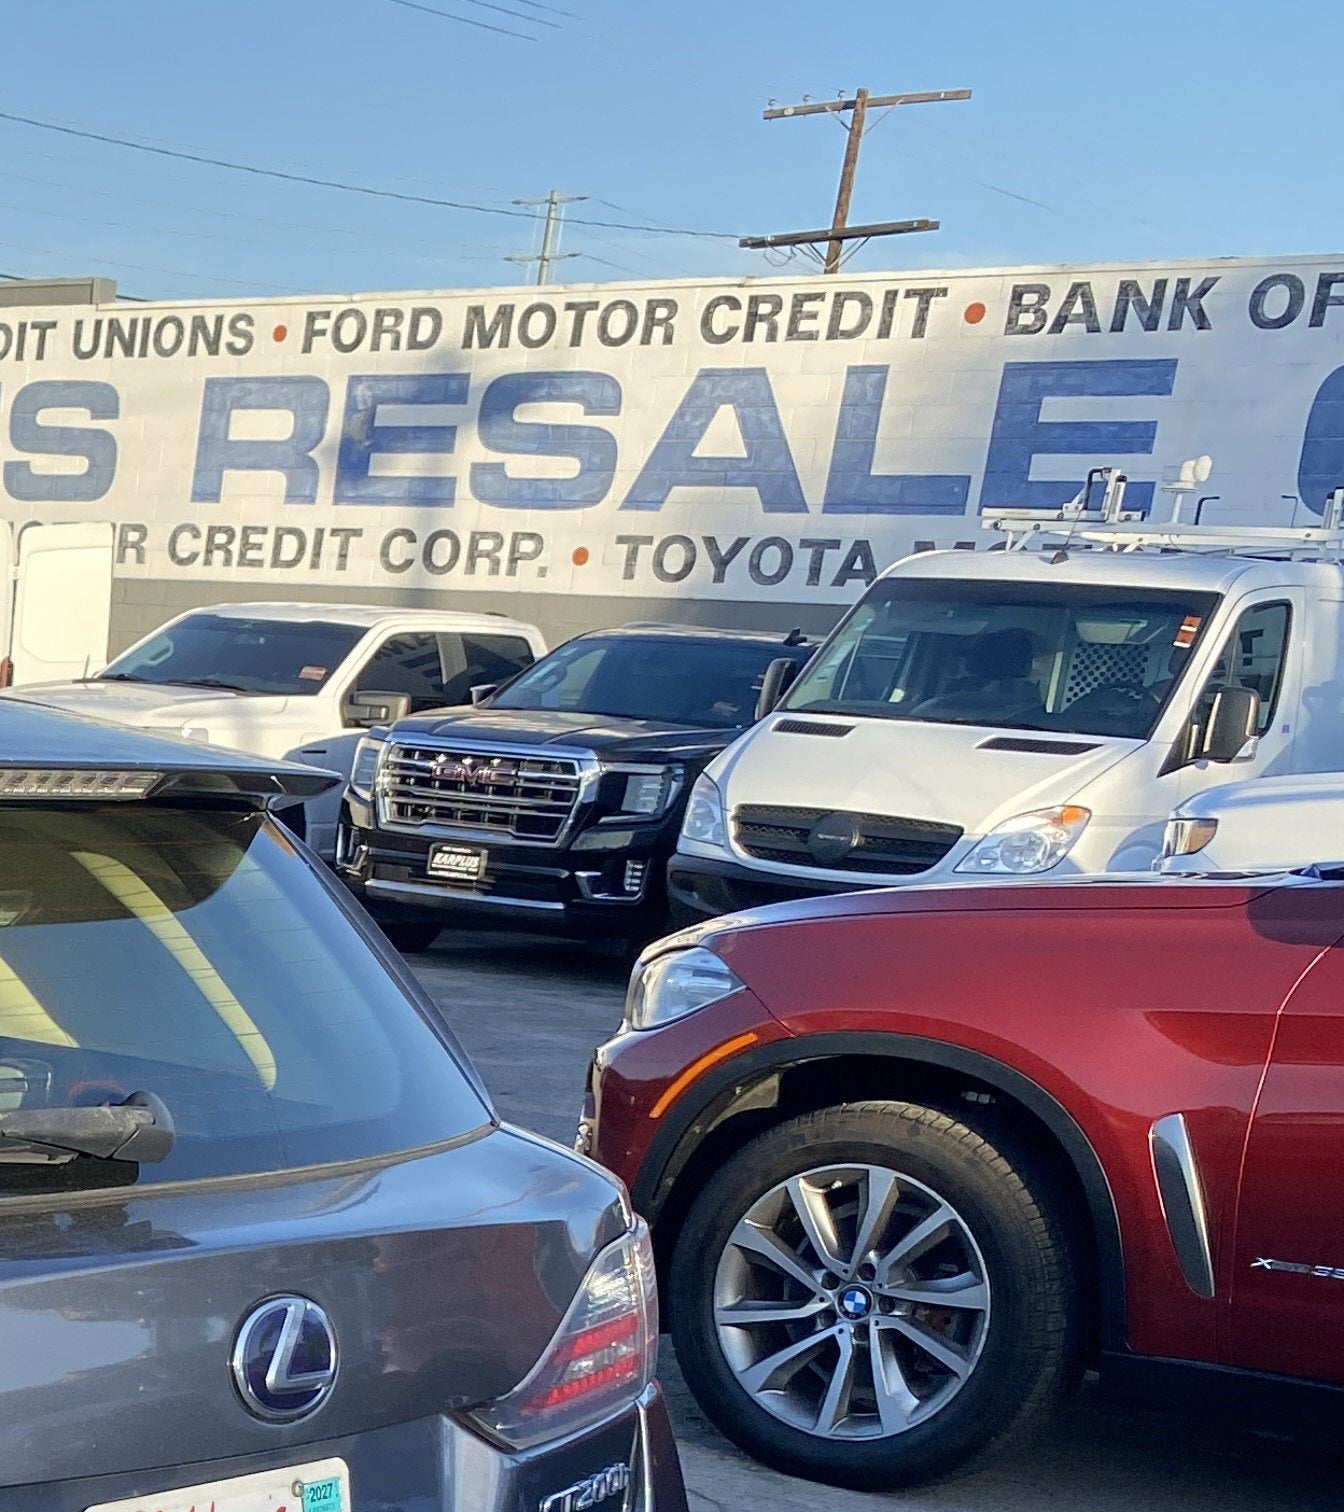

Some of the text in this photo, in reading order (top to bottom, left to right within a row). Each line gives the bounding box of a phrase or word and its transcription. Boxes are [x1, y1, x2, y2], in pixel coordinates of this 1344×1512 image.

[71, 313, 255, 361] UNIONS
[301, 307, 443, 354] FORD
[461, 298, 679, 350] MOTOR
[700, 286, 949, 344] CREDIT
[1003, 275, 1221, 336] BANK
[1248, 272, 1344, 330] OF
[190, 357, 1179, 518] RESALE
[167, 521, 363, 570] CREDIT
[379, 528, 547, 578] CORP.
[615, 533, 879, 588] TOYOTA
[309, 1482, 333, 1502] 2027
